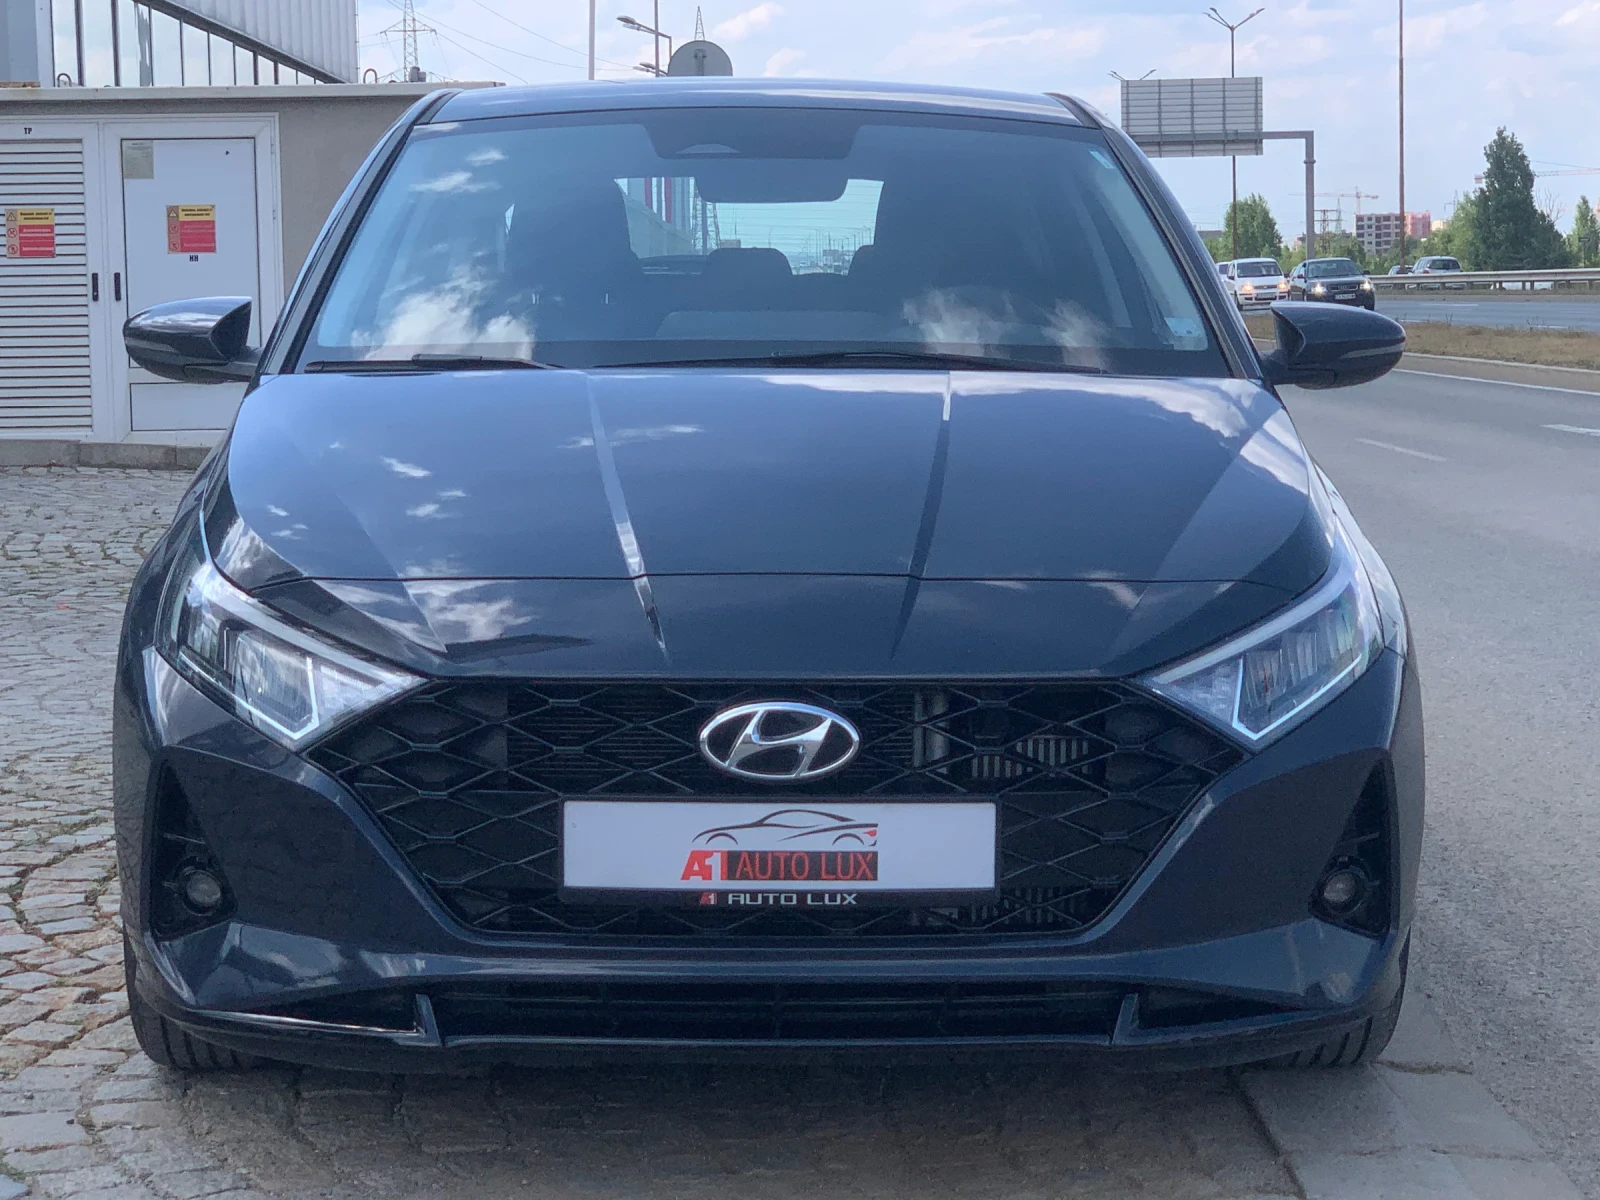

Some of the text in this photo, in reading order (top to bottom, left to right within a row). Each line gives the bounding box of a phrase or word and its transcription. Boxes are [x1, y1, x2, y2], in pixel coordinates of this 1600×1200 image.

[681, 850, 874, 880] A1 AUTO LUX
[699, 892, 858, 905] A1 AUTO LUX
